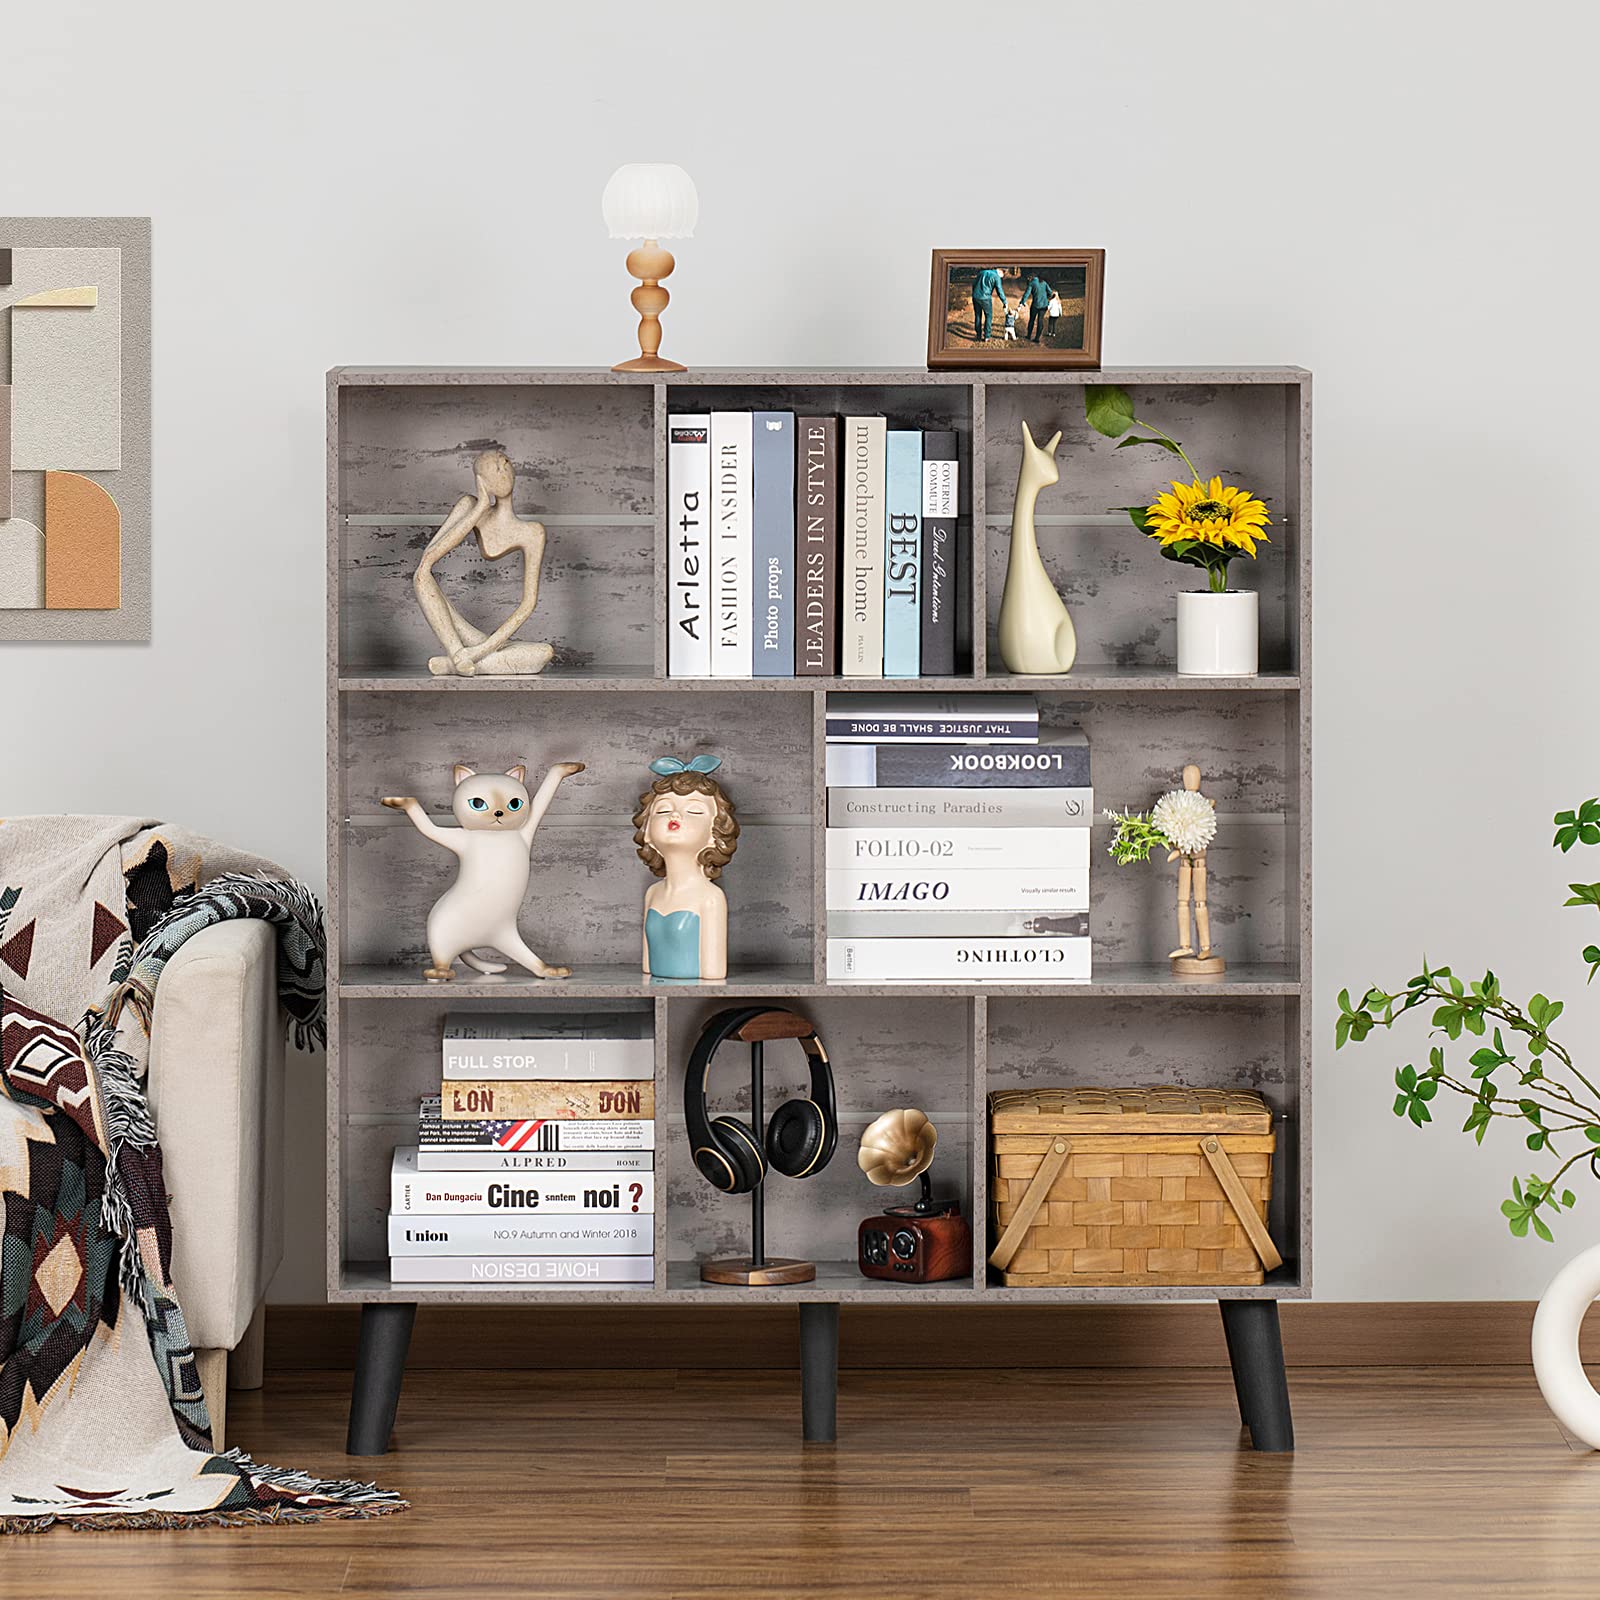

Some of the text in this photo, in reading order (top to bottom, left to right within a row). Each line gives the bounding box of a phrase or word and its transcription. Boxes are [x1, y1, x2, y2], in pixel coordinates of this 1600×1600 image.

[929, 462, 938, 514] COMMUTE
[941, 462, 950, 516] COVERING
[854, 426, 874, 622] monochrome home
[806, 426, 825, 667] LEADERS IN STYLE
[677, 491, 699, 640] Arletta
[888, 512, 918, 605] BEST
[721, 556, 738, 647] FASHION
[764, 557, 782, 650] Photo props
[851, 723, 1011, 734] THAT JUSTICE SHALL BE DONE
[951, 754, 1062, 770] LOOKBOOK
[846, 801, 1003, 815] Constructing Paradies
[855, 839, 954, 857] FOLIO-02
[856, 882, 950, 901] IMAGO
[957, 949, 1065, 963] CLOTHING
[448, 1055, 537, 1070] FULL STOP.
[500, 1157, 568, 1168] ALPRED
[425, 1193, 442, 1201] Dan
[444, 1193, 482, 1203] Dungaciu
[487, 1184, 539, 1208] Cine
[583, 1184, 619, 1208] noi
[405, 1229, 449, 1242] Union
[494, 1229, 637, 1240] NO.9 Autumn and Winter 2018
[546, 1262, 599, 1278] HOME
